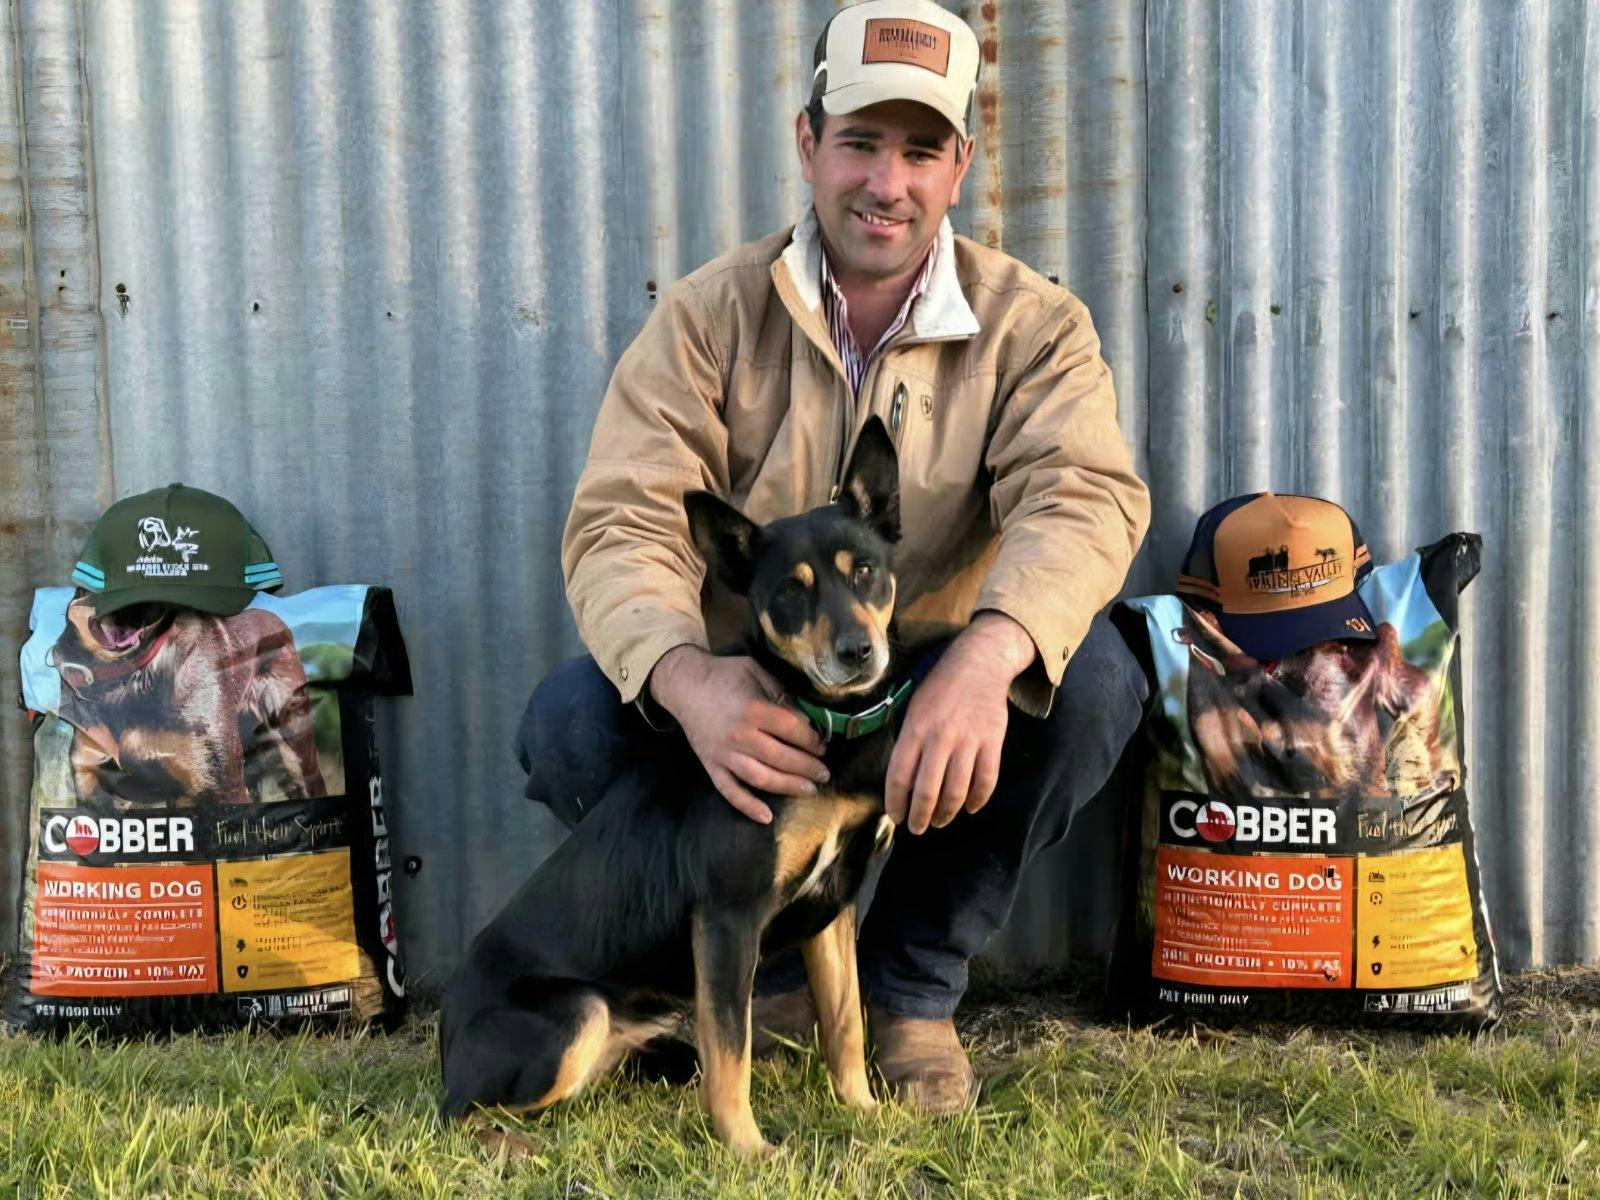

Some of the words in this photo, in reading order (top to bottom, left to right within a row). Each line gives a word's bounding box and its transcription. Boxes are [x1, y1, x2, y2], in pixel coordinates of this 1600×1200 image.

[45, 815, 194, 856] COBBER
[1169, 800, 1337, 844] COBBER
[44, 880, 142, 900] WORKING
[150, 880, 202, 899] DOG
[1168, 864, 1280, 890] WORKING
[1289, 865, 1342, 891] DOG
